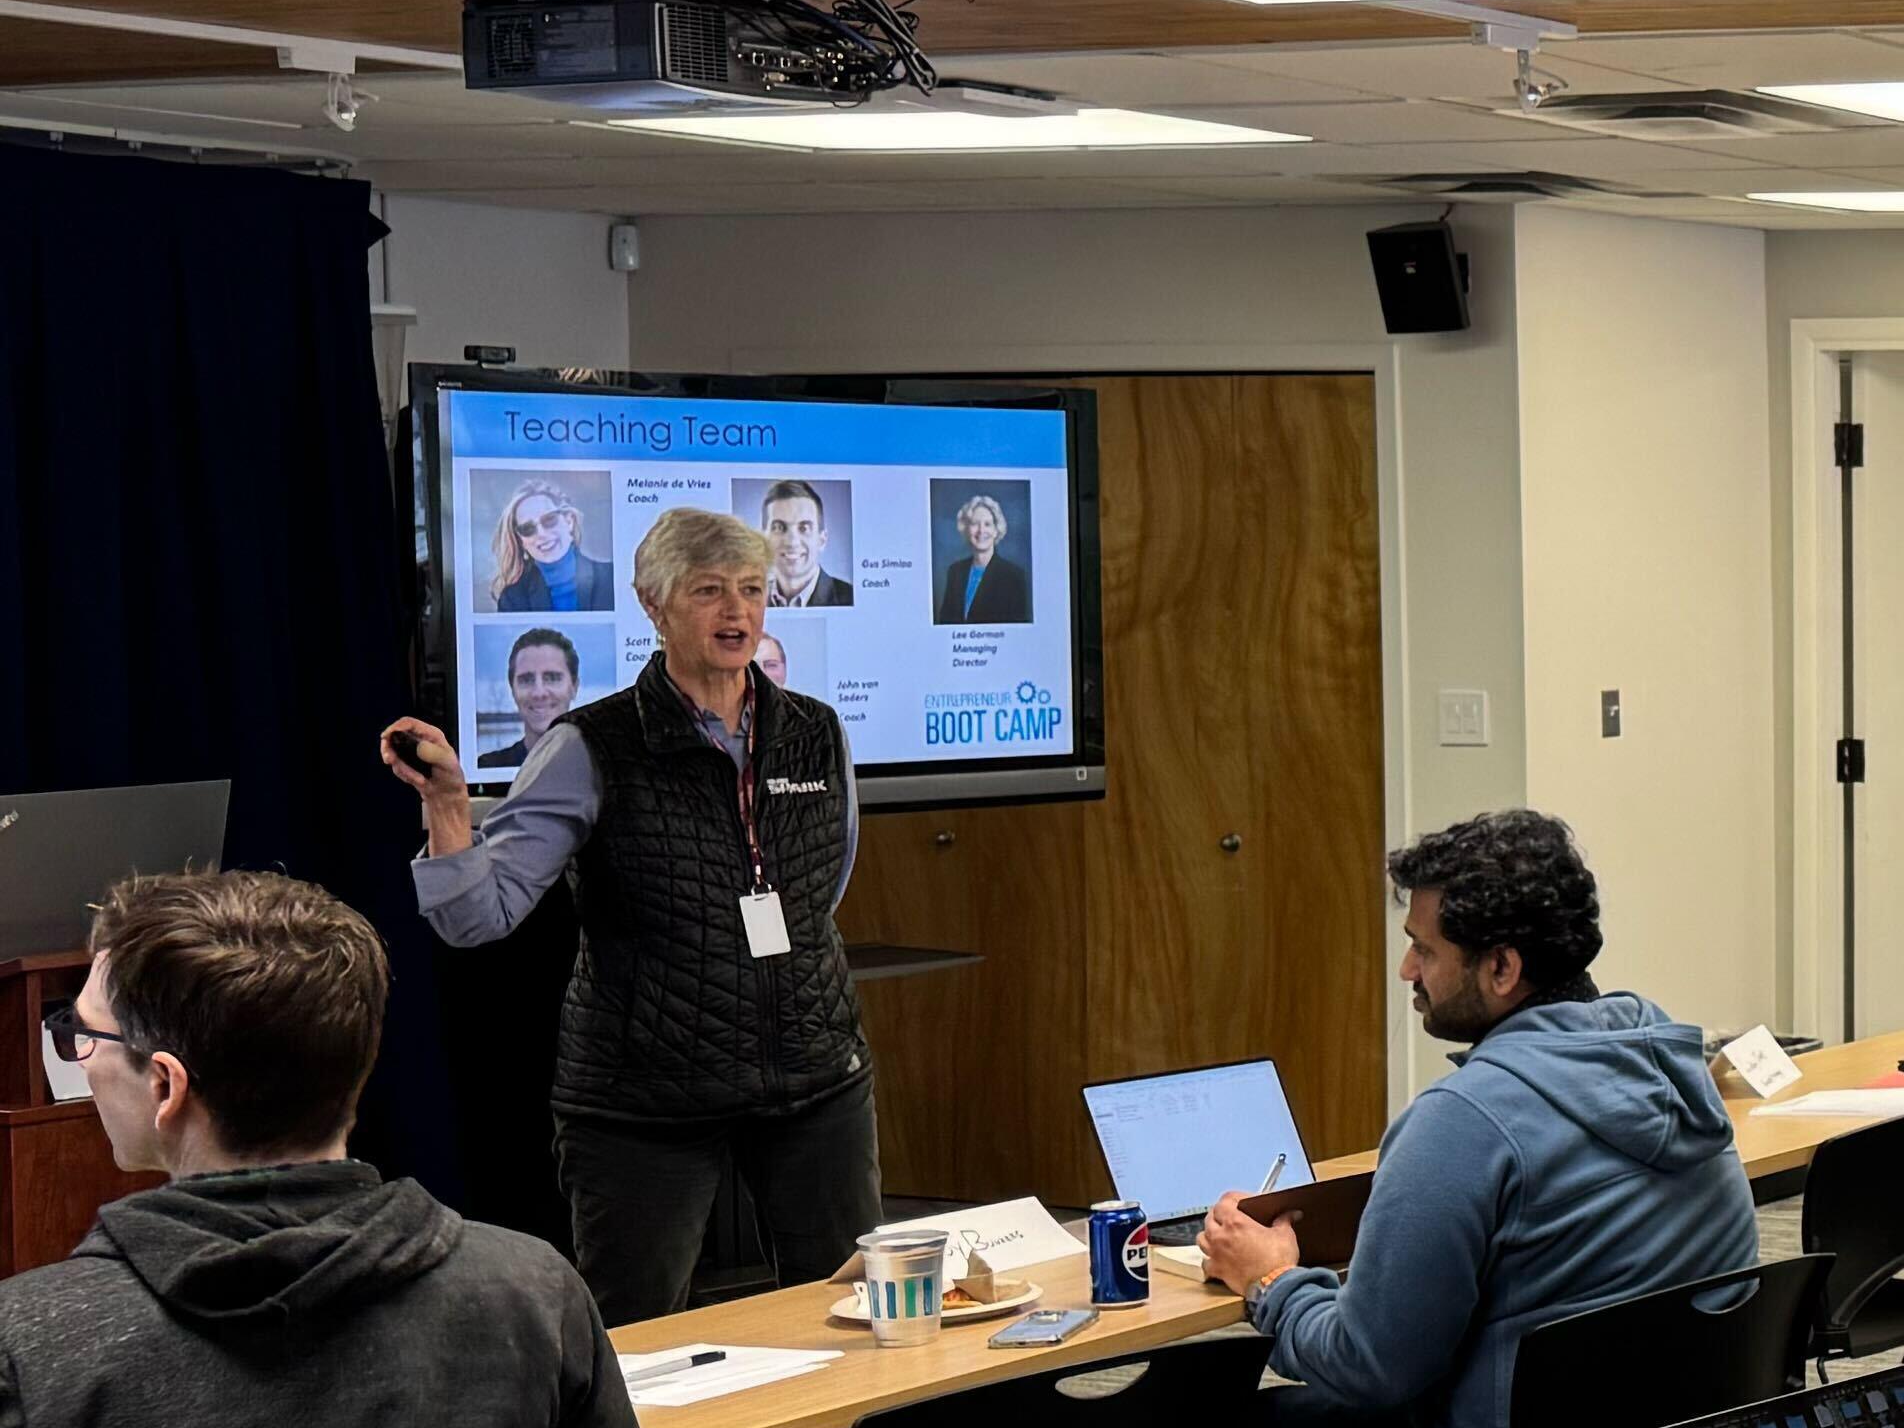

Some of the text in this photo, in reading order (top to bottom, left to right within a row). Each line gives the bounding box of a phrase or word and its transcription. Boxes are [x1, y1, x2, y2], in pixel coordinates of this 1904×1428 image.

[504, 411, 777, 451] Teaching Team
[627, 478, 711, 490] Melanie de Vries
[627, 493, 659, 504] Coach
[862, 579, 890, 589] Coach
[626, 637, 651, 647] Scott
[953, 644, 997, 656] Managing
[953, 659, 988, 668] Director
[924, 692, 1012, 709] ENTREPRENEUR
[841, 712, 866, 722] oach
[926, 707, 1062, 745] BOOT CAMP
